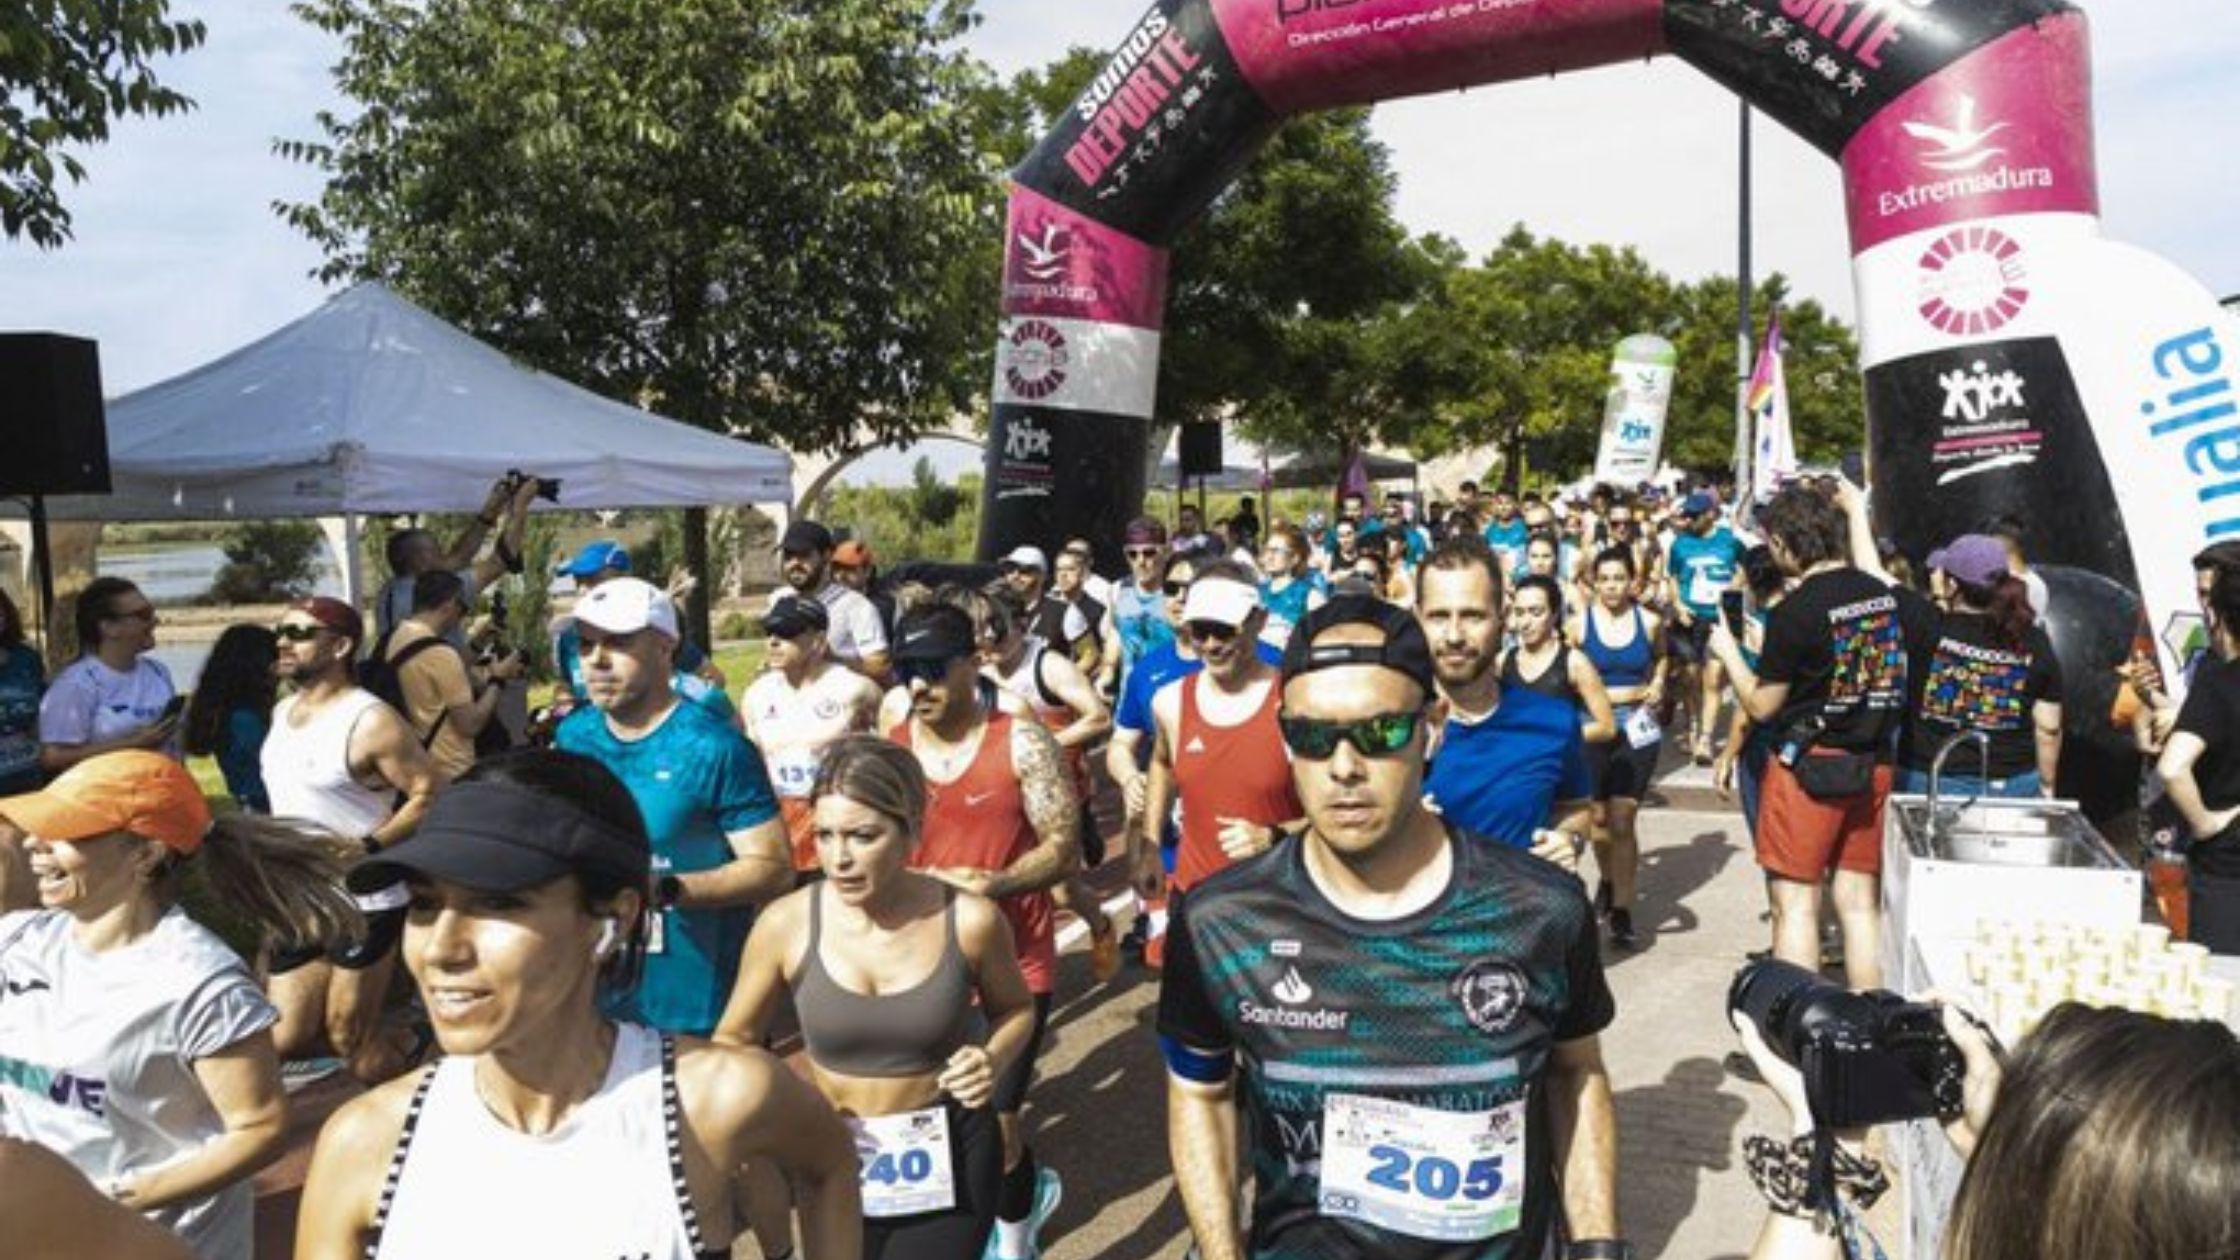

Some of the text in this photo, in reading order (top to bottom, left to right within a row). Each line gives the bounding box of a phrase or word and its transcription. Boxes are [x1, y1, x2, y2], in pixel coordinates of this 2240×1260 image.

[1063, 26, 1201, 186] DEPORTE
[1878, 163, 2054, 216] Extremadura
[1238, 1000, 1349, 1030] Santander
[1365, 1143, 1504, 1201] 205
